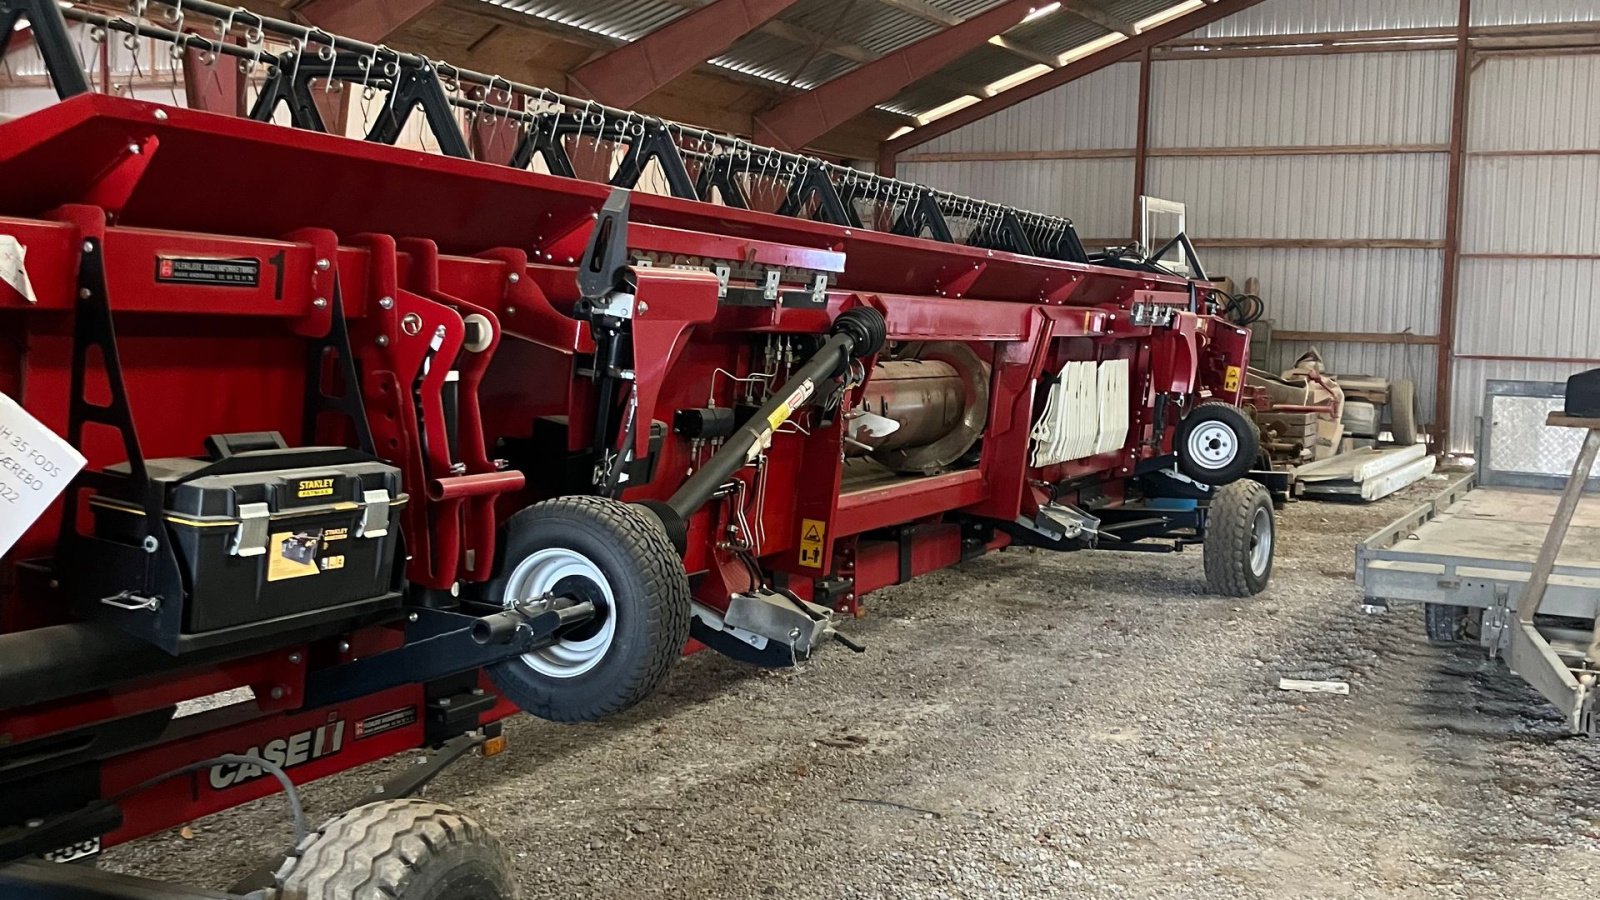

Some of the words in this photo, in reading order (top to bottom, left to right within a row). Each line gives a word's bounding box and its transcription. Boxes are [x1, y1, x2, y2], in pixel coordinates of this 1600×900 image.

[269, 250, 285, 300] 1
[10, 436, 30, 452] 35
[27, 449, 62, 477] FODS
[298, 478, 335, 490] STANLEY
[209, 730, 312, 789] CASE
